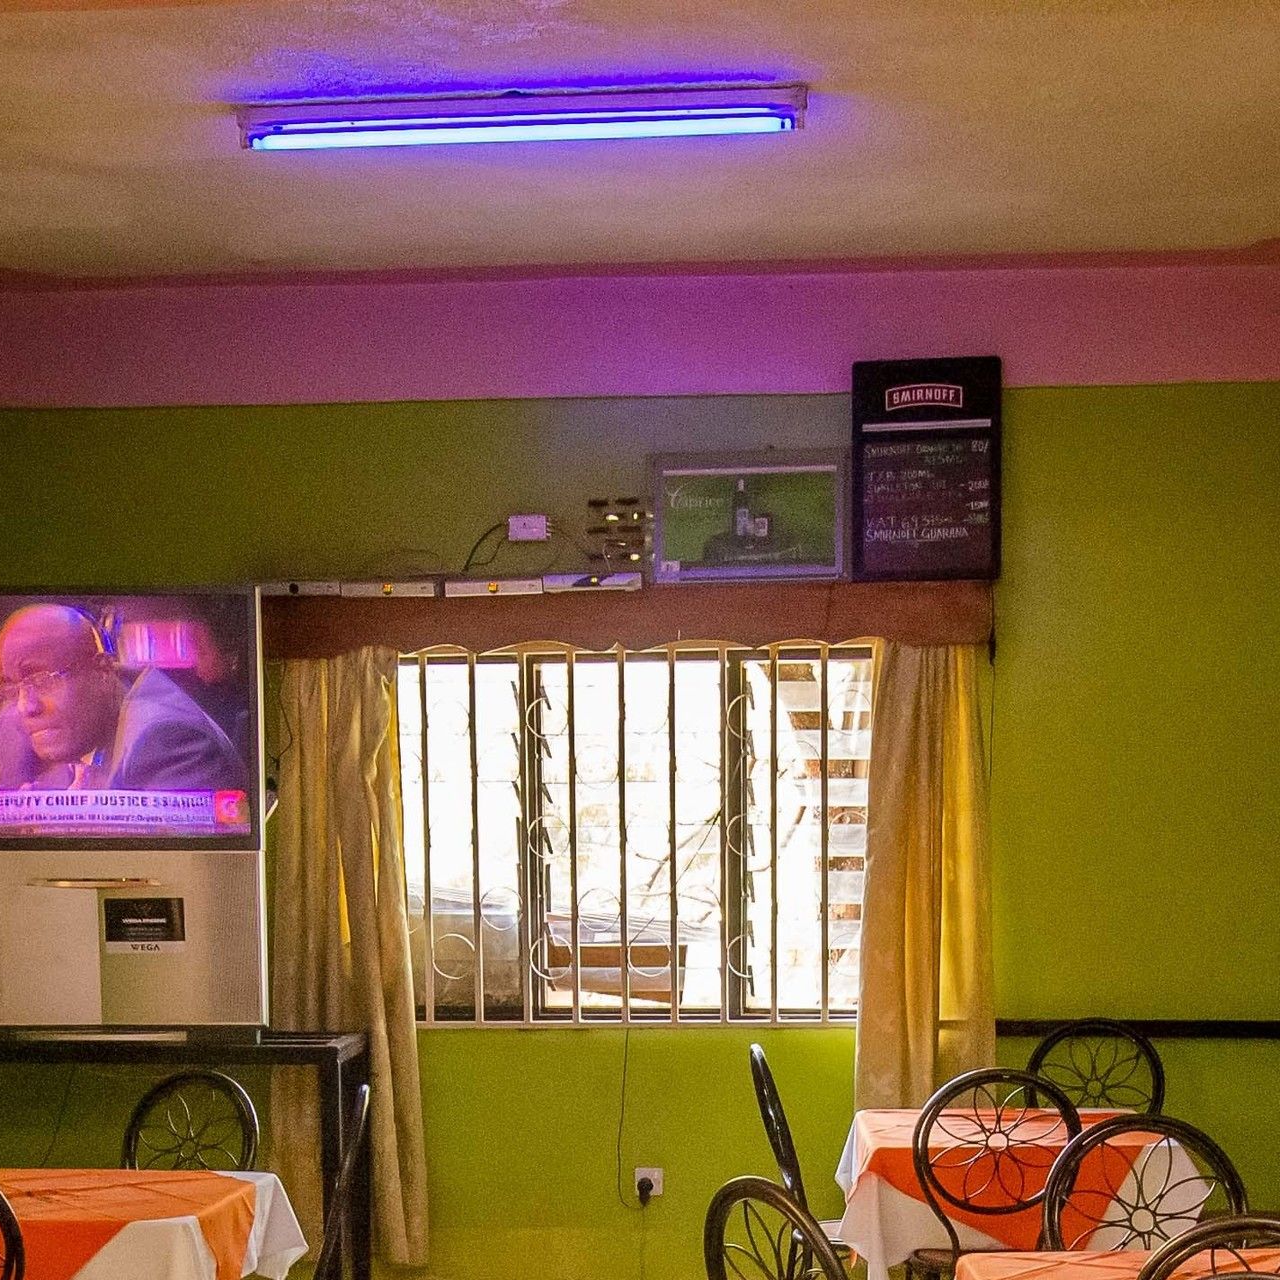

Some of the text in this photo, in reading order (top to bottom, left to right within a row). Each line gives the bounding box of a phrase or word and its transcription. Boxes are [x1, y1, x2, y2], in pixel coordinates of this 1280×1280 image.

[892, 387, 956, 405] SMIRNOFF
[45, 795, 88, 807] CHIEF
[92, 795, 148, 808] JUSTICE
[130, 943, 161, 952] WEGA
